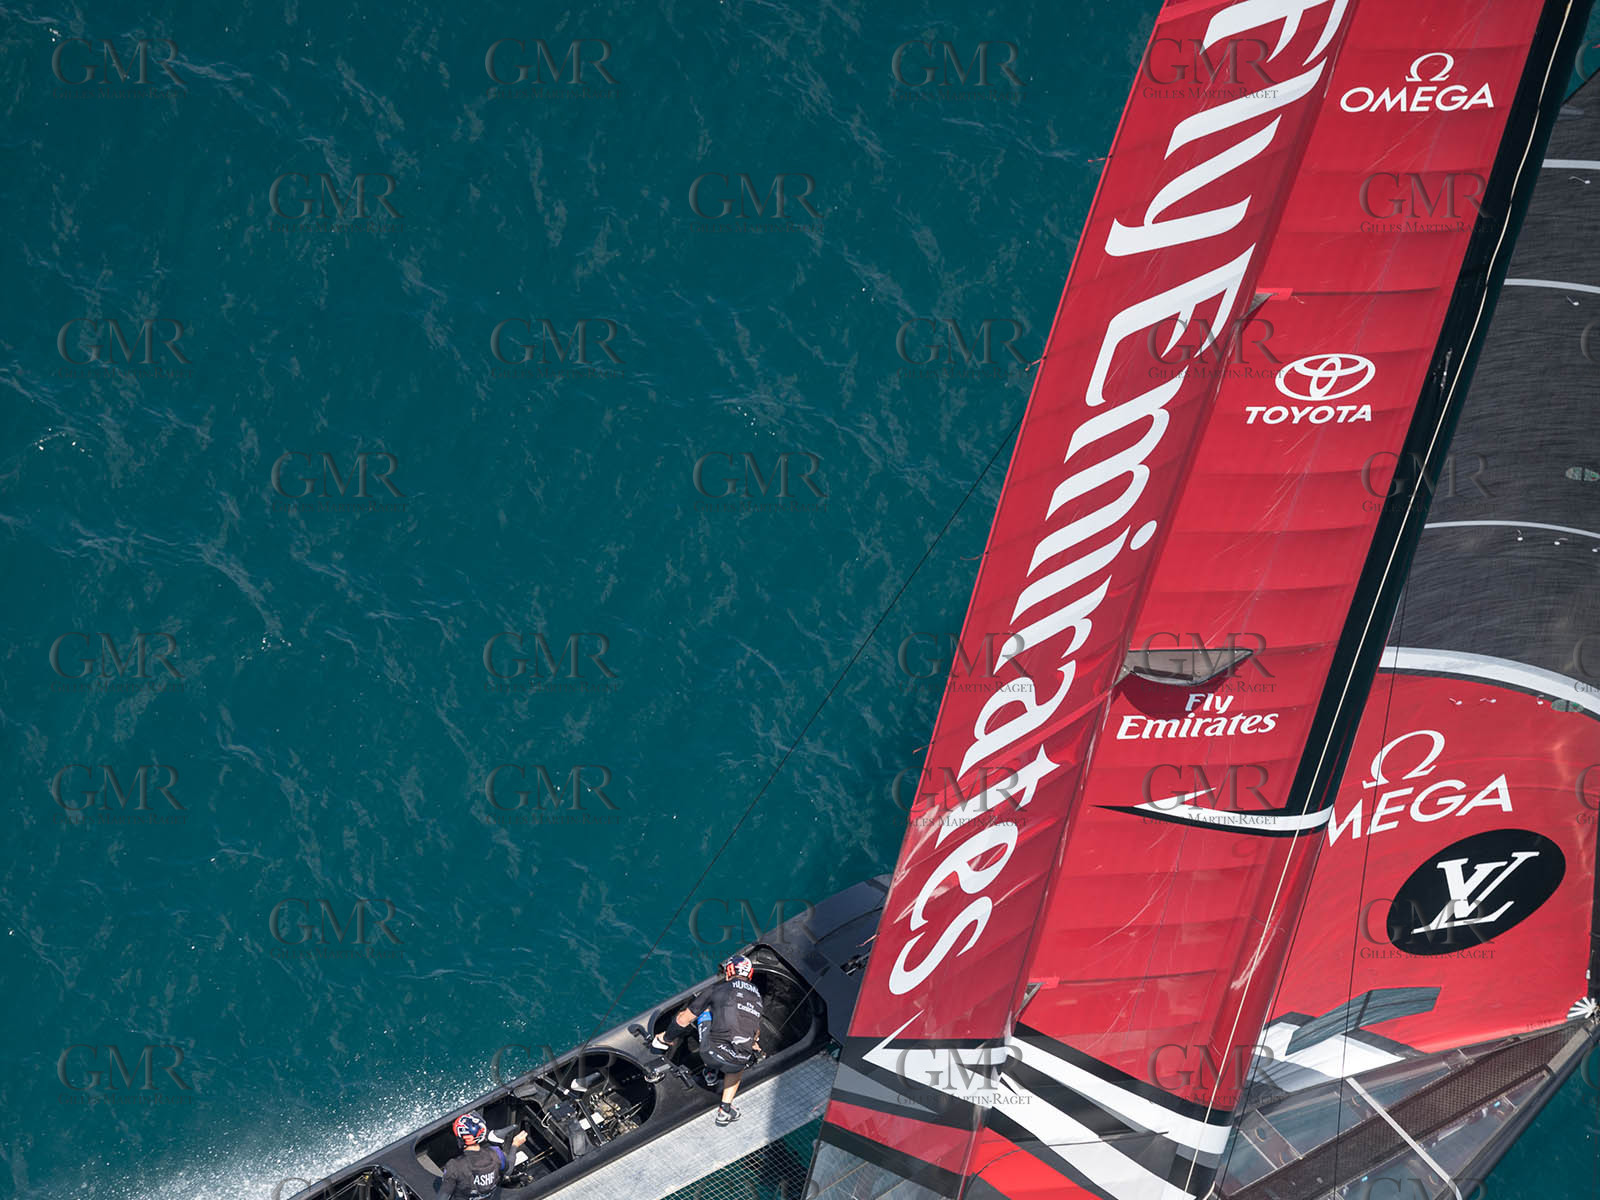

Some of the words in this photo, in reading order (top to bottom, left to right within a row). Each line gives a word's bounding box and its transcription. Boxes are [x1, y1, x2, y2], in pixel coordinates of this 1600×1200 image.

[1340, 82, 1494, 112] OMEGA
[1104, 0, 1348, 257] Fly
[1244, 404, 1372, 425] TOYOTA
[889, 242, 1256, 995] Emirates
[1185, 693, 1234, 714] Fly
[1116, 712, 1279, 740] Emirates
[1327, 773, 1513, 847] MEGA
